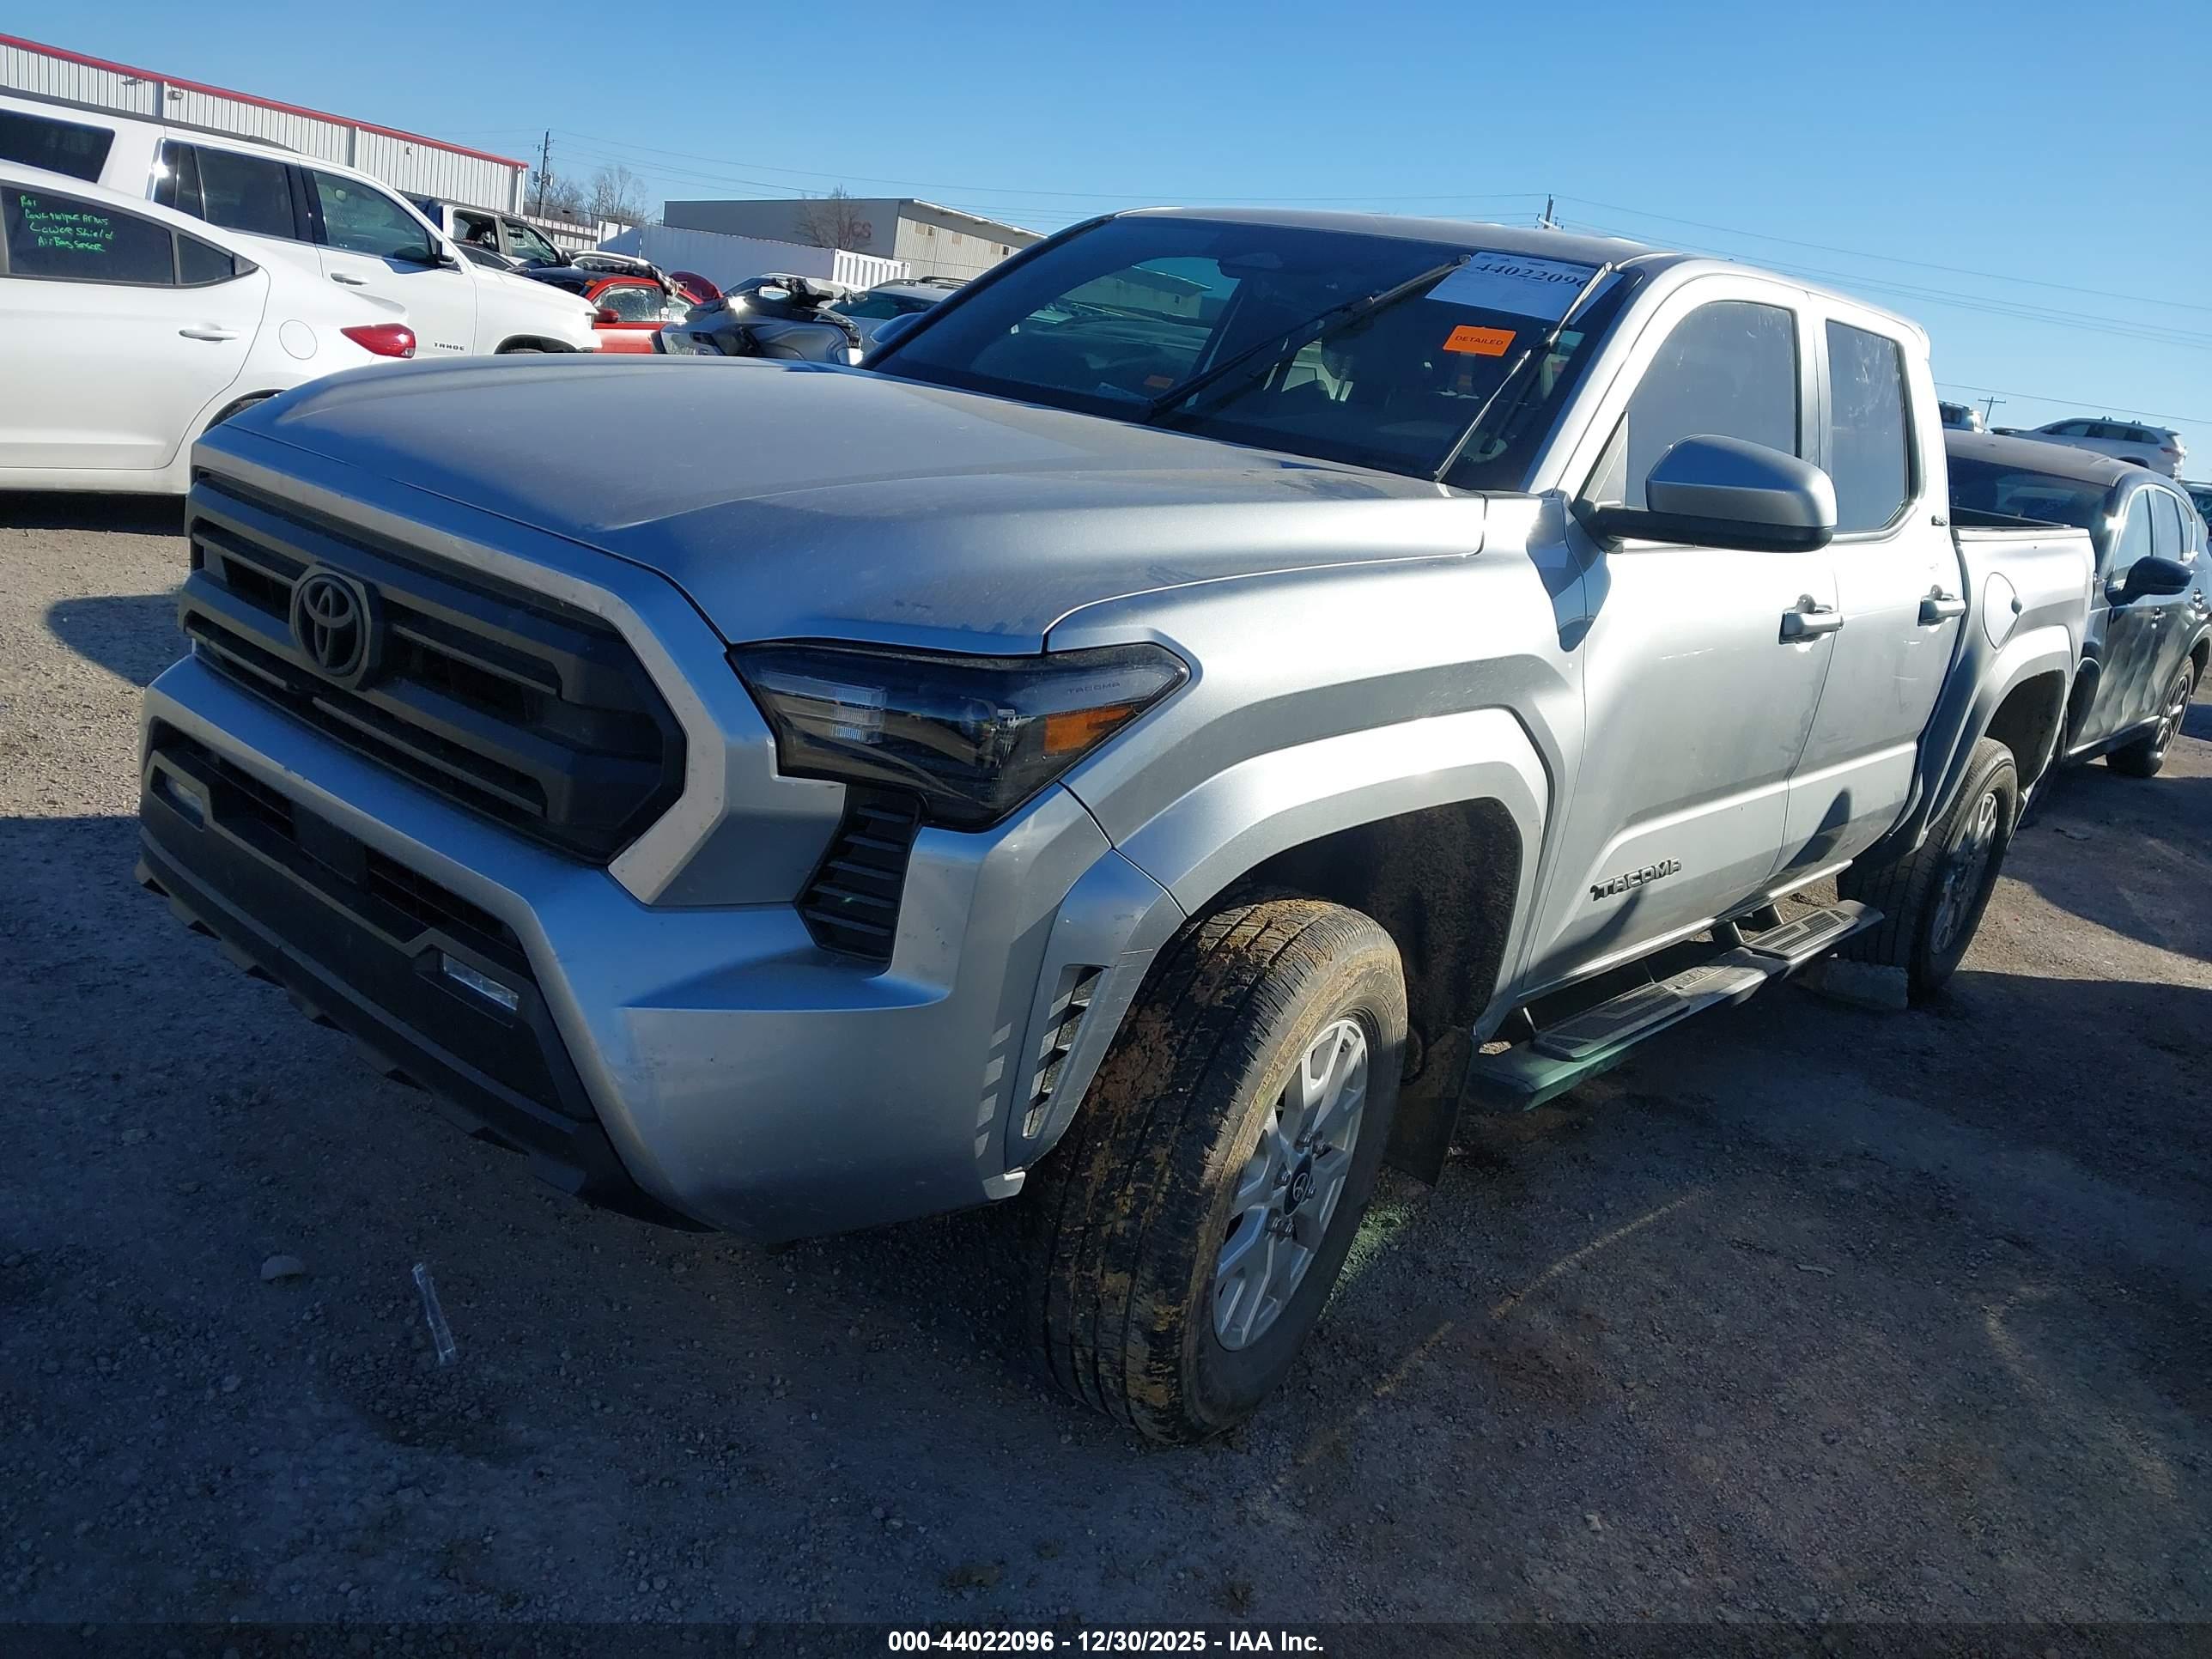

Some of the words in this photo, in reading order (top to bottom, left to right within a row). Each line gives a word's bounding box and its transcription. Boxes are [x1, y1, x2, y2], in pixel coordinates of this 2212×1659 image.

[1455, 336, 1504, 345] DETAILED
[434, 342, 465, 351] TAHOE
[1590, 858, 1682, 901] TACOMA
